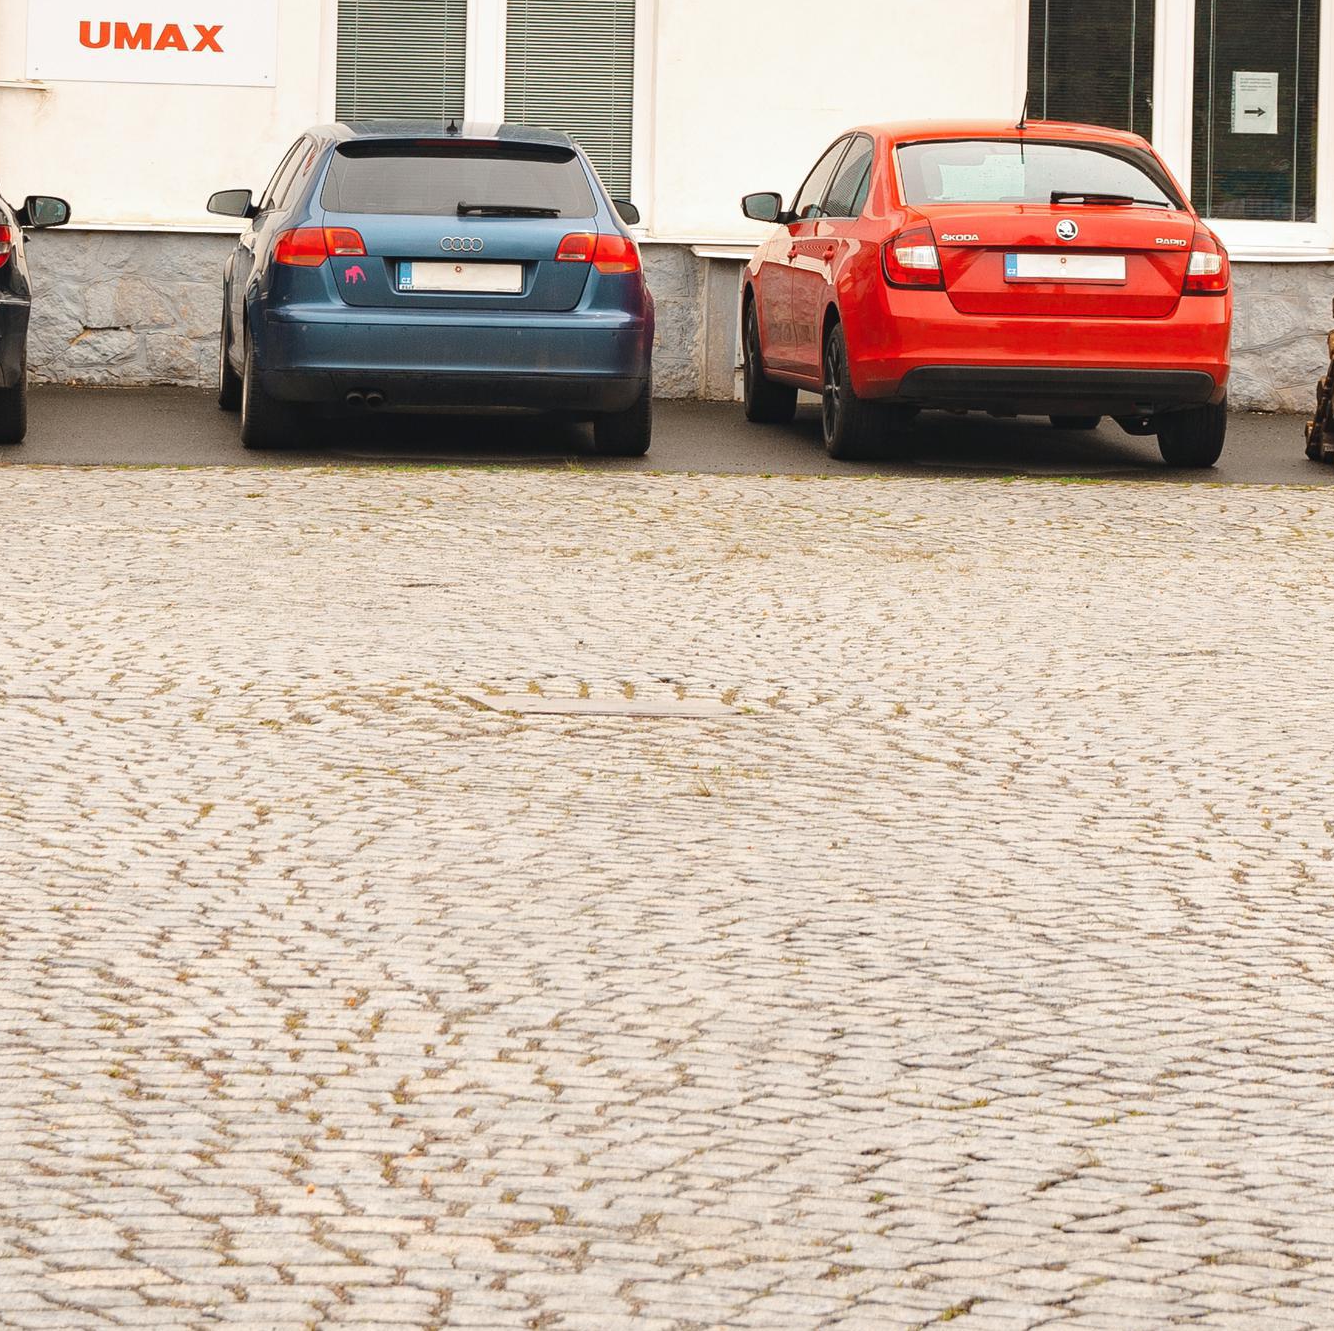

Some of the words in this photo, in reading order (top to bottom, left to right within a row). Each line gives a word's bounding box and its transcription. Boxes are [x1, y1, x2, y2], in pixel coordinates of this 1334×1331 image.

[79, 21, 224, 52] UMAX
[941, 233, 979, 241] ŠKODA
[1155, 237, 1187, 246] RAPID
